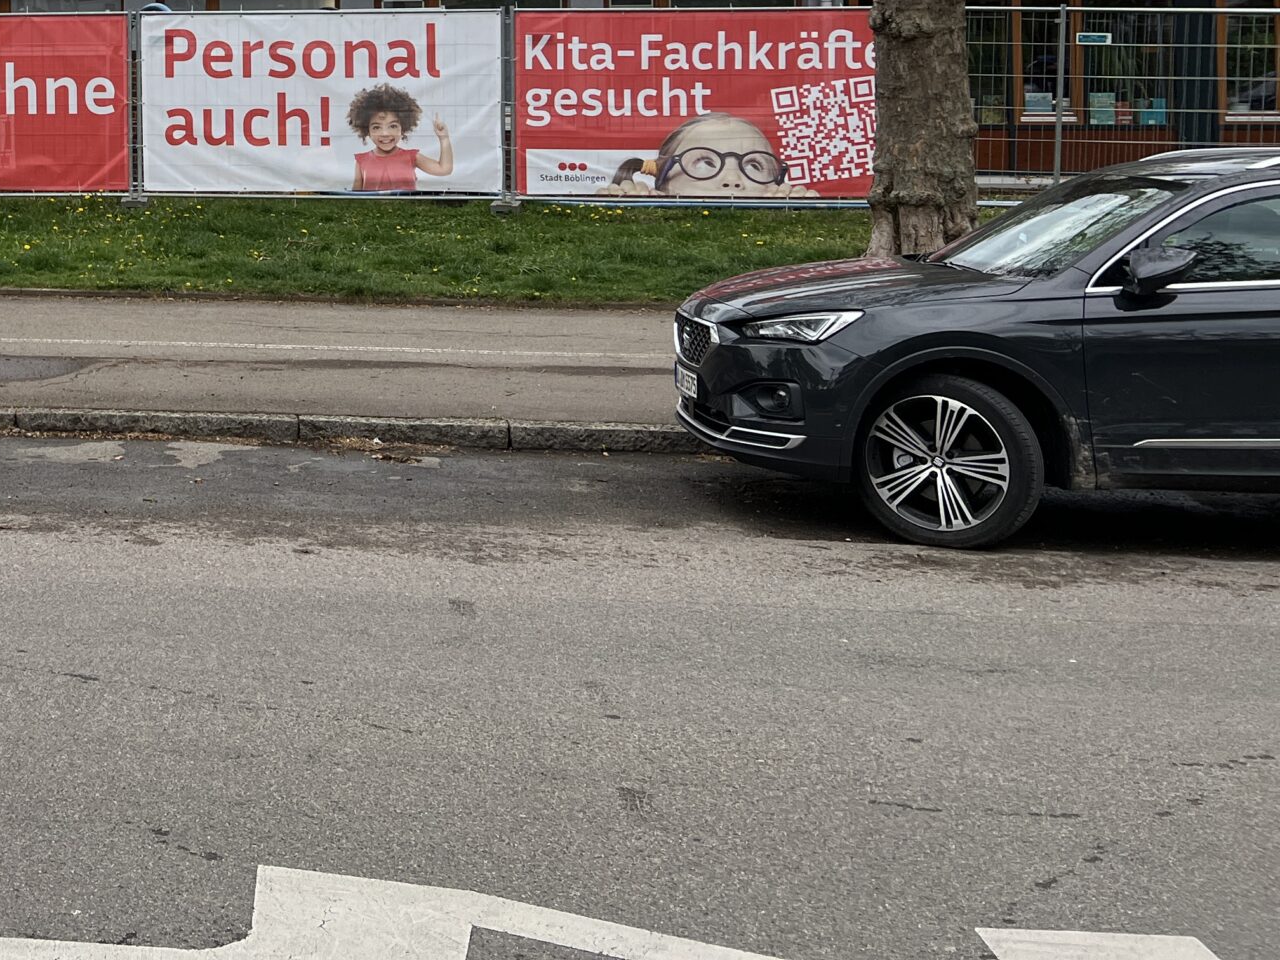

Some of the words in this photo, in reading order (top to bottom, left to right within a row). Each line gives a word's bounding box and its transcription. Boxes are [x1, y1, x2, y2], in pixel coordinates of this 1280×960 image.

[165, 23, 440, 79] Personal
[165, 92, 331, 147] auch!
[525, 76, 712, 128] gesucht
[539, 173, 563, 182] Stadt
[564, 173, 606, 184] Böblingen
